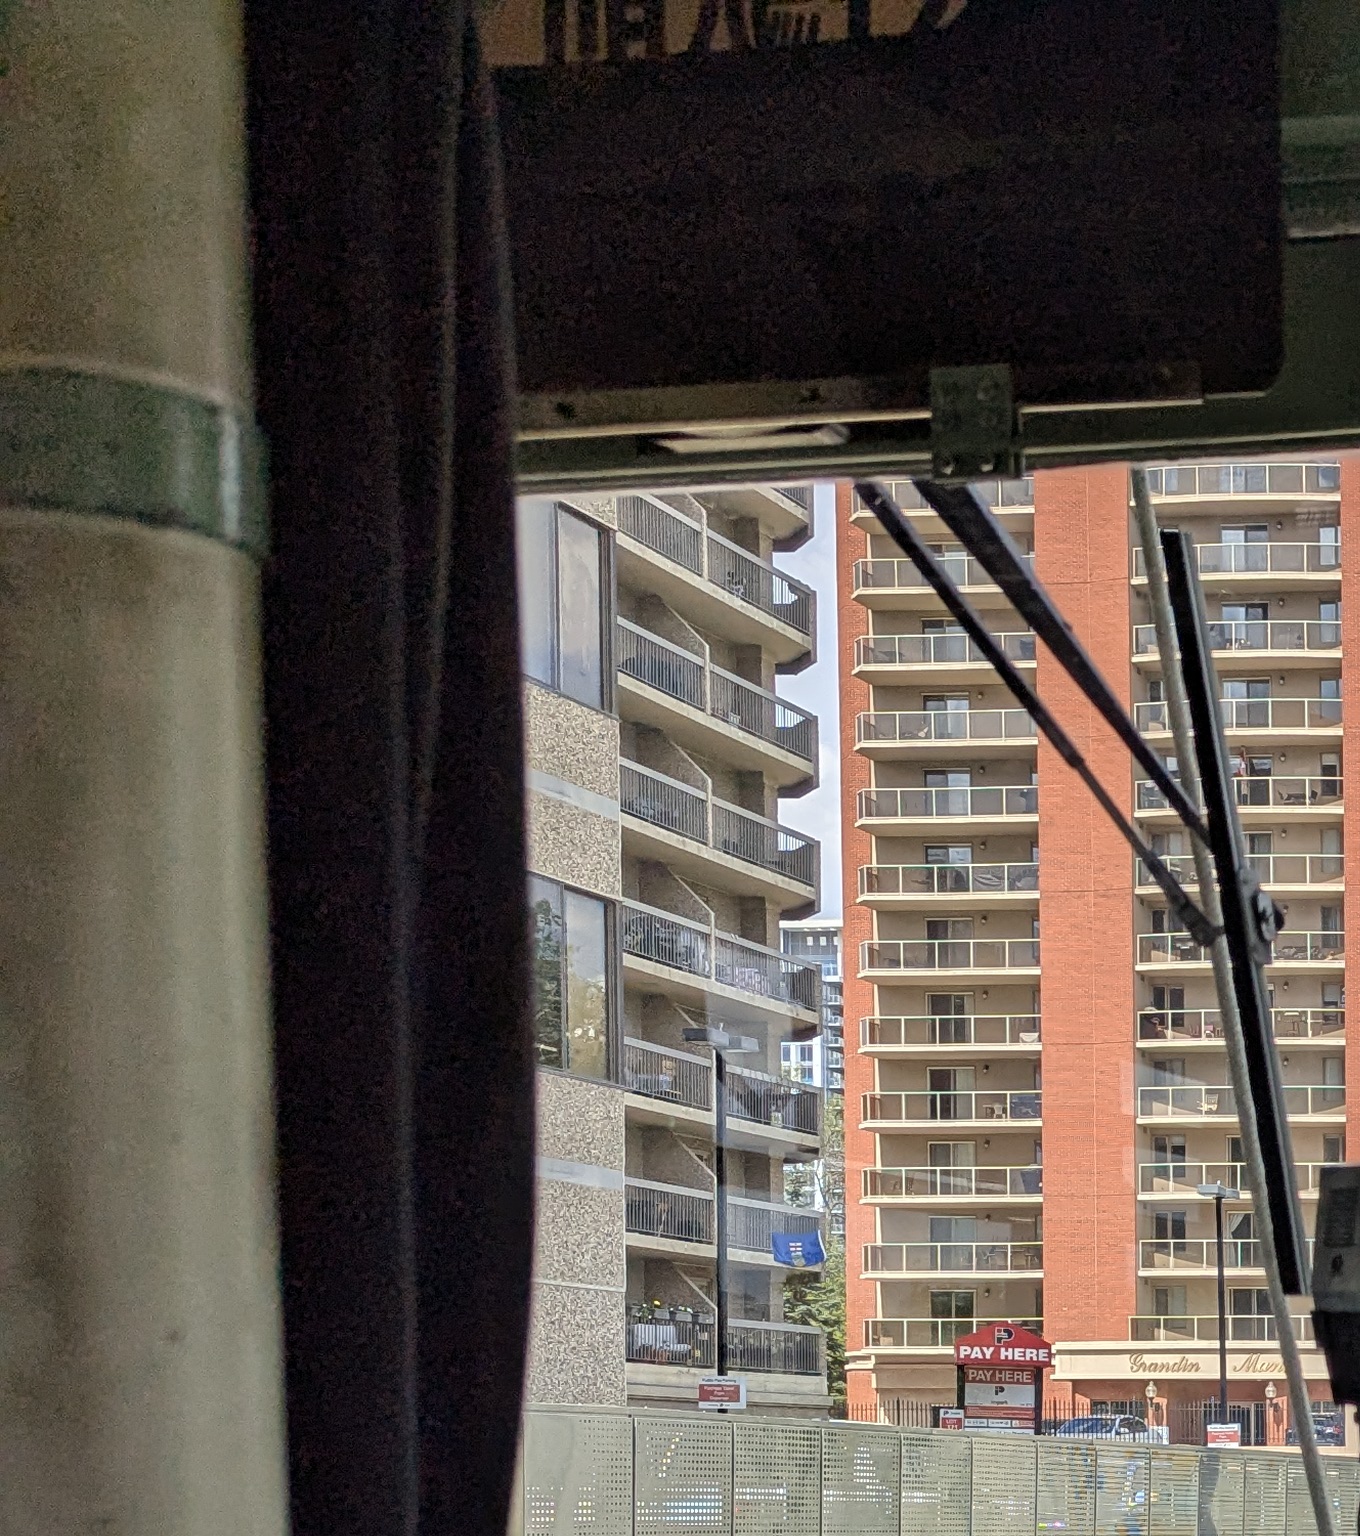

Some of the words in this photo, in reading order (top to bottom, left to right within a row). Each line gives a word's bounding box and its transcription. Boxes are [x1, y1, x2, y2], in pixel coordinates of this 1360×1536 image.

[959, 1345, 995, 1360] PAY
[1000, 1347, 1048, 1361] HERE
[1129, 1352, 1201, 1374] Grandin
[1232, 1352, 1287, 1374] Man
[968, 1369, 993, 1381] PAY
[995, 1370, 1031, 1382] HERE
